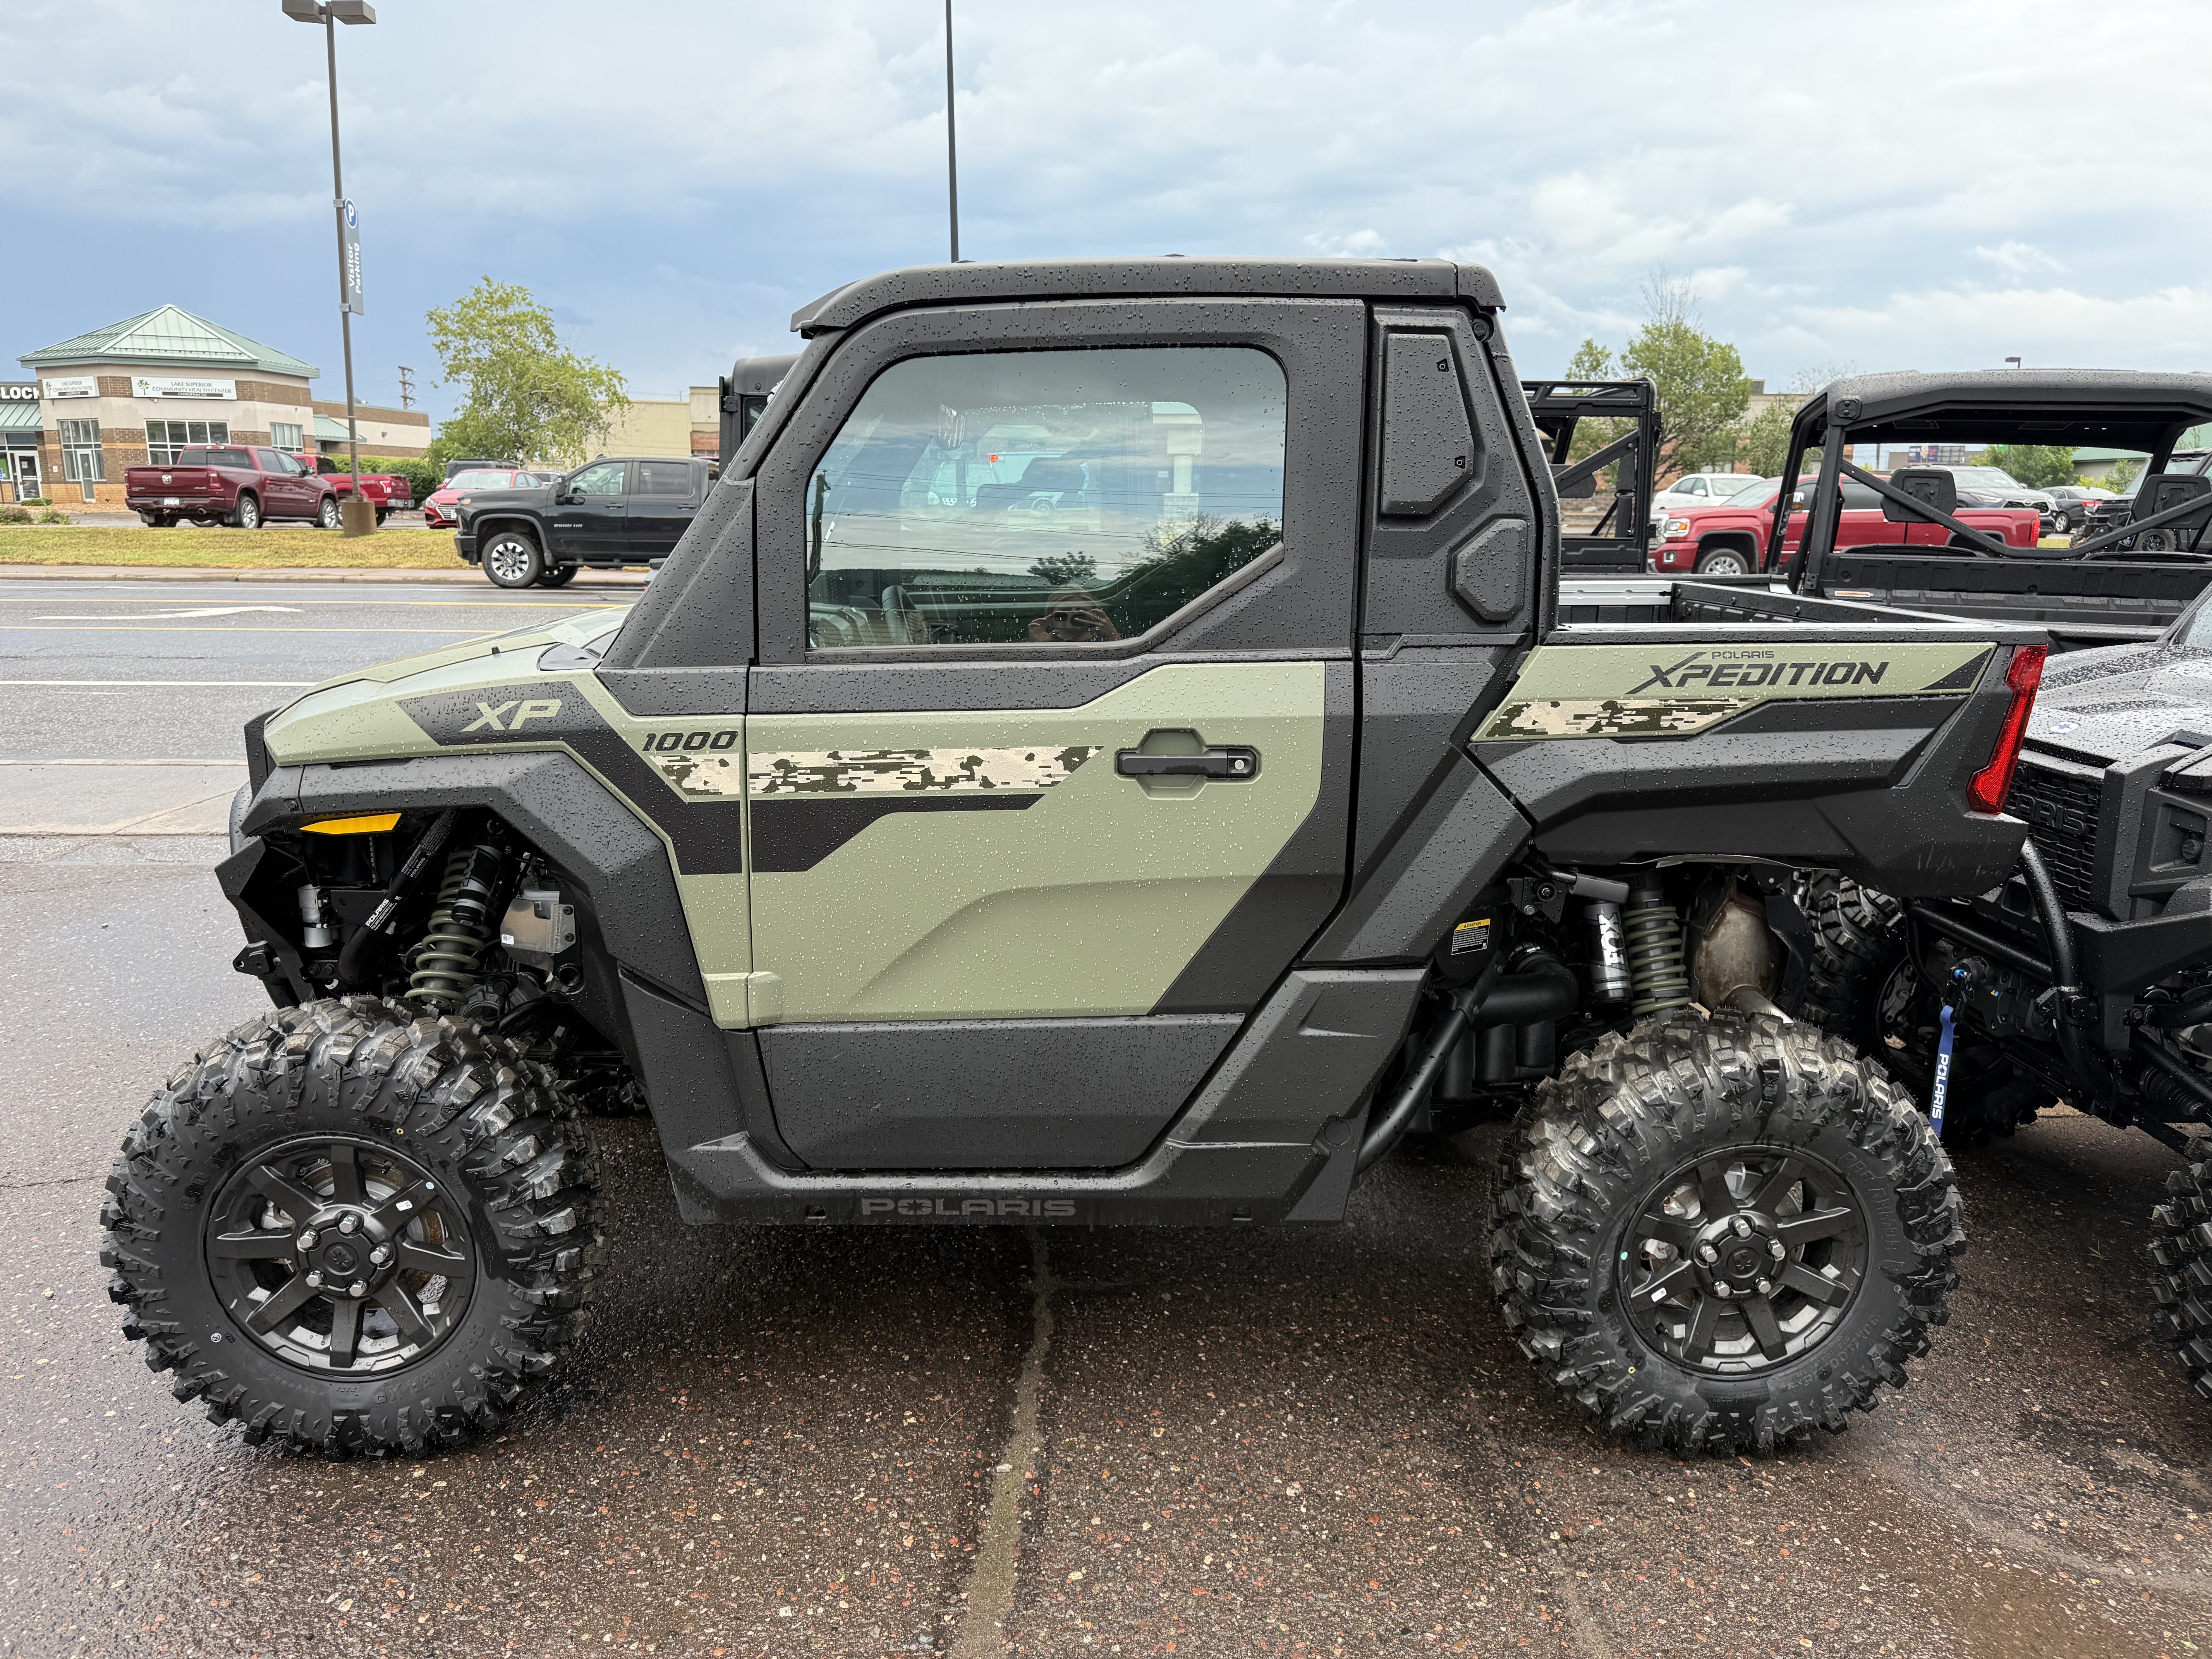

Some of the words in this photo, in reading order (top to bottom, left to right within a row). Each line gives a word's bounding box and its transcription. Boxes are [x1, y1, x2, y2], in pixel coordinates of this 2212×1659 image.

[0, 386, 40, 399] LOCK
[1712, 651, 1774, 659] POLARIS
[1623, 651, 1890, 695] XPEDITION
[459, 699, 562, 732] XP
[642, 731, 738, 751] 1000
[365, 898, 389, 927] POLARIS
[1597, 912, 1625, 966] FOX
[1932, 1053, 1949, 1120] POLARIS
[860, 1198, 1077, 1216] POLARIS
